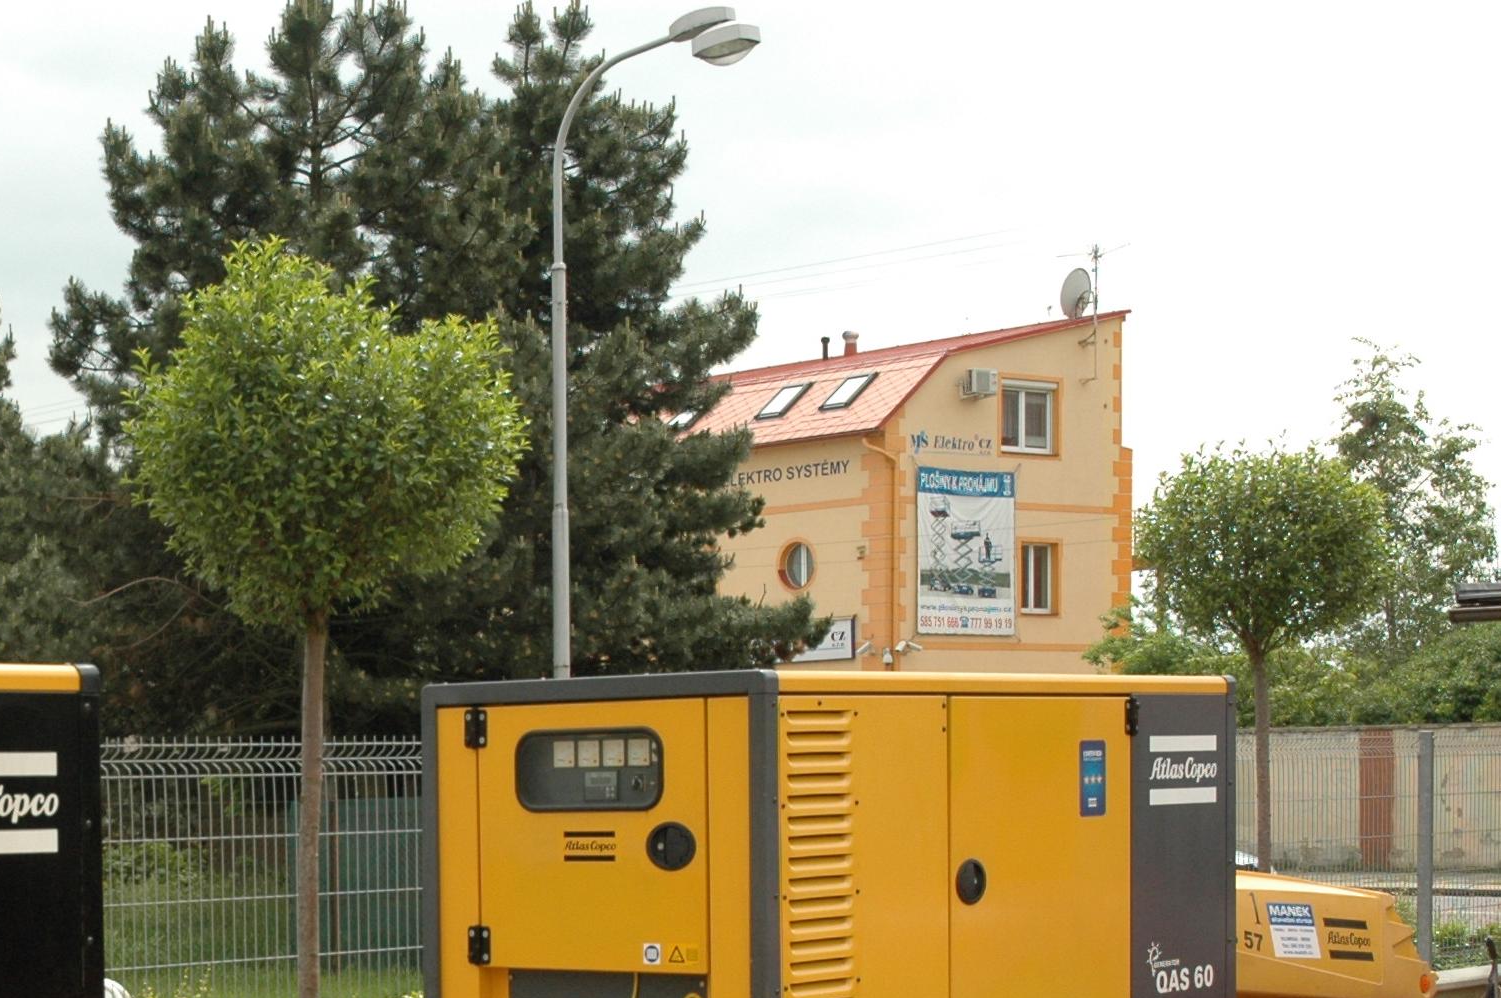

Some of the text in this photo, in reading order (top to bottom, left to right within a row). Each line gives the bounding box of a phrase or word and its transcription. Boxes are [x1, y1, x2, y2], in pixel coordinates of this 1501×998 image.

[934, 435, 975, 451] Elektro
[978, 438, 993, 449] CZ
[723, 459, 850, 487] LEKTRO SYSTÉMY
[970, 617, 982, 629] 777
[831, 631, 845, 641] CZ
[1149, 756, 1217, 783] Atlas Copco
[564, 840, 616, 852] Atlas Copco
[1268, 904, 1311, 917] MANEK
[1244, 931, 1263, 952] 57
[1327, 930, 1371, 949] Atlas Copco
[1156, 964, 1214, 994] QAS 60
